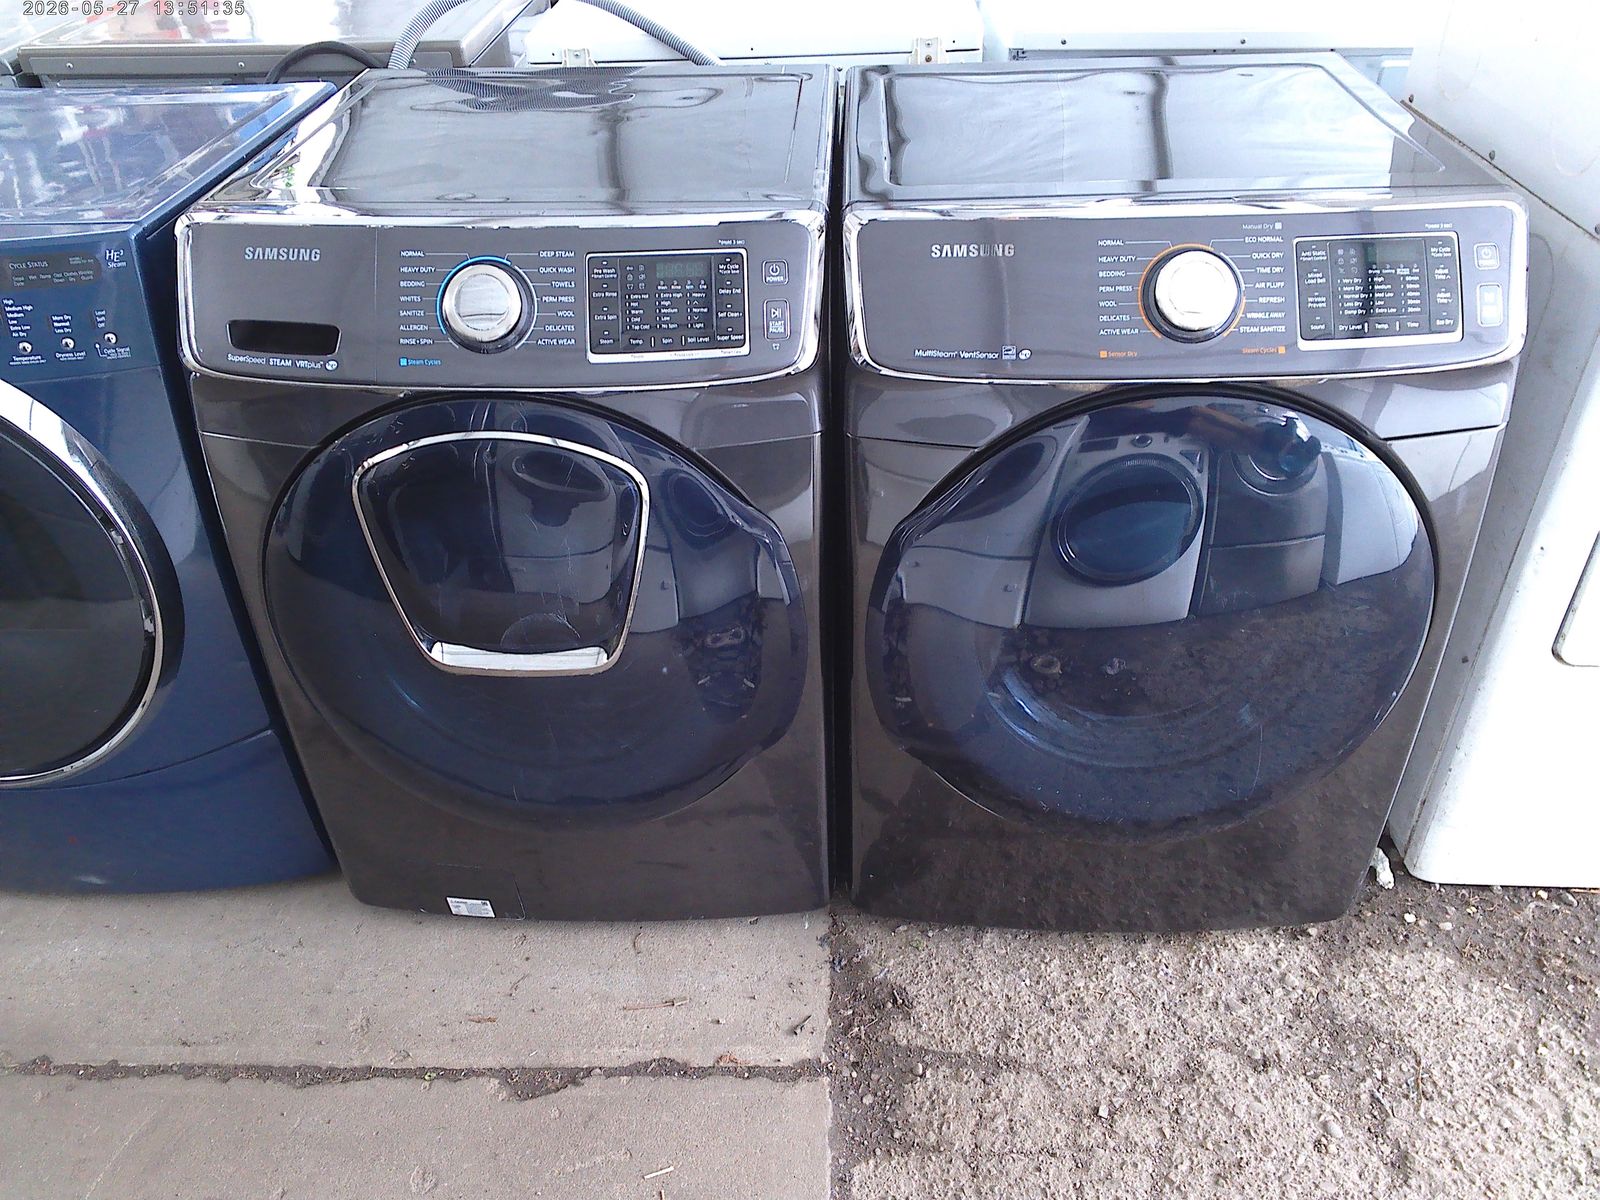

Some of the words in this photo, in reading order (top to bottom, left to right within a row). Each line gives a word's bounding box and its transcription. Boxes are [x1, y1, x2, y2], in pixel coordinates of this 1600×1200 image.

[1263, 223, 1273, 231] Dry
[245, 246, 320, 261] SAMSUNG
[931, 244, 1014, 258] SAMSUNG
[228, 354, 266, 364] SuperSpeed
[270, 358, 292, 367] STEAM
[960, 351, 999, 359] VentSensor
